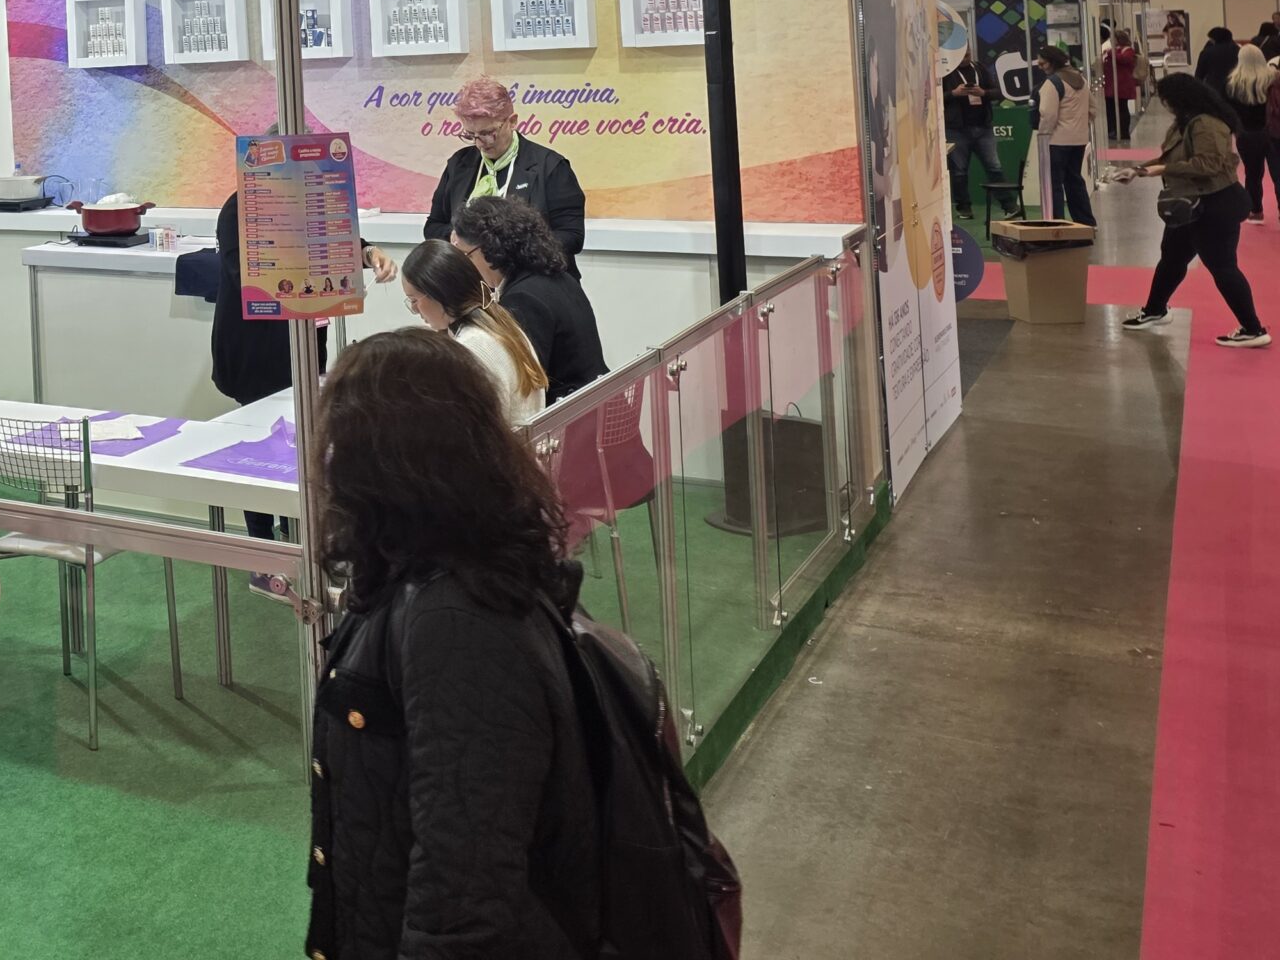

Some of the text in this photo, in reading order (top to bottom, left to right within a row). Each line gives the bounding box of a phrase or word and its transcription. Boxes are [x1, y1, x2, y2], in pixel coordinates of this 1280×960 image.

[364, 85, 385, 108] A
[389, 89, 422, 107] cor
[522, 82, 620, 109] imagina,
[421, 121, 433, 137] o
[549, 118, 590, 144] que
[596, 112, 649, 135] você
[652, 112, 708, 135] cria.
[993, 126, 1013, 137] EST
